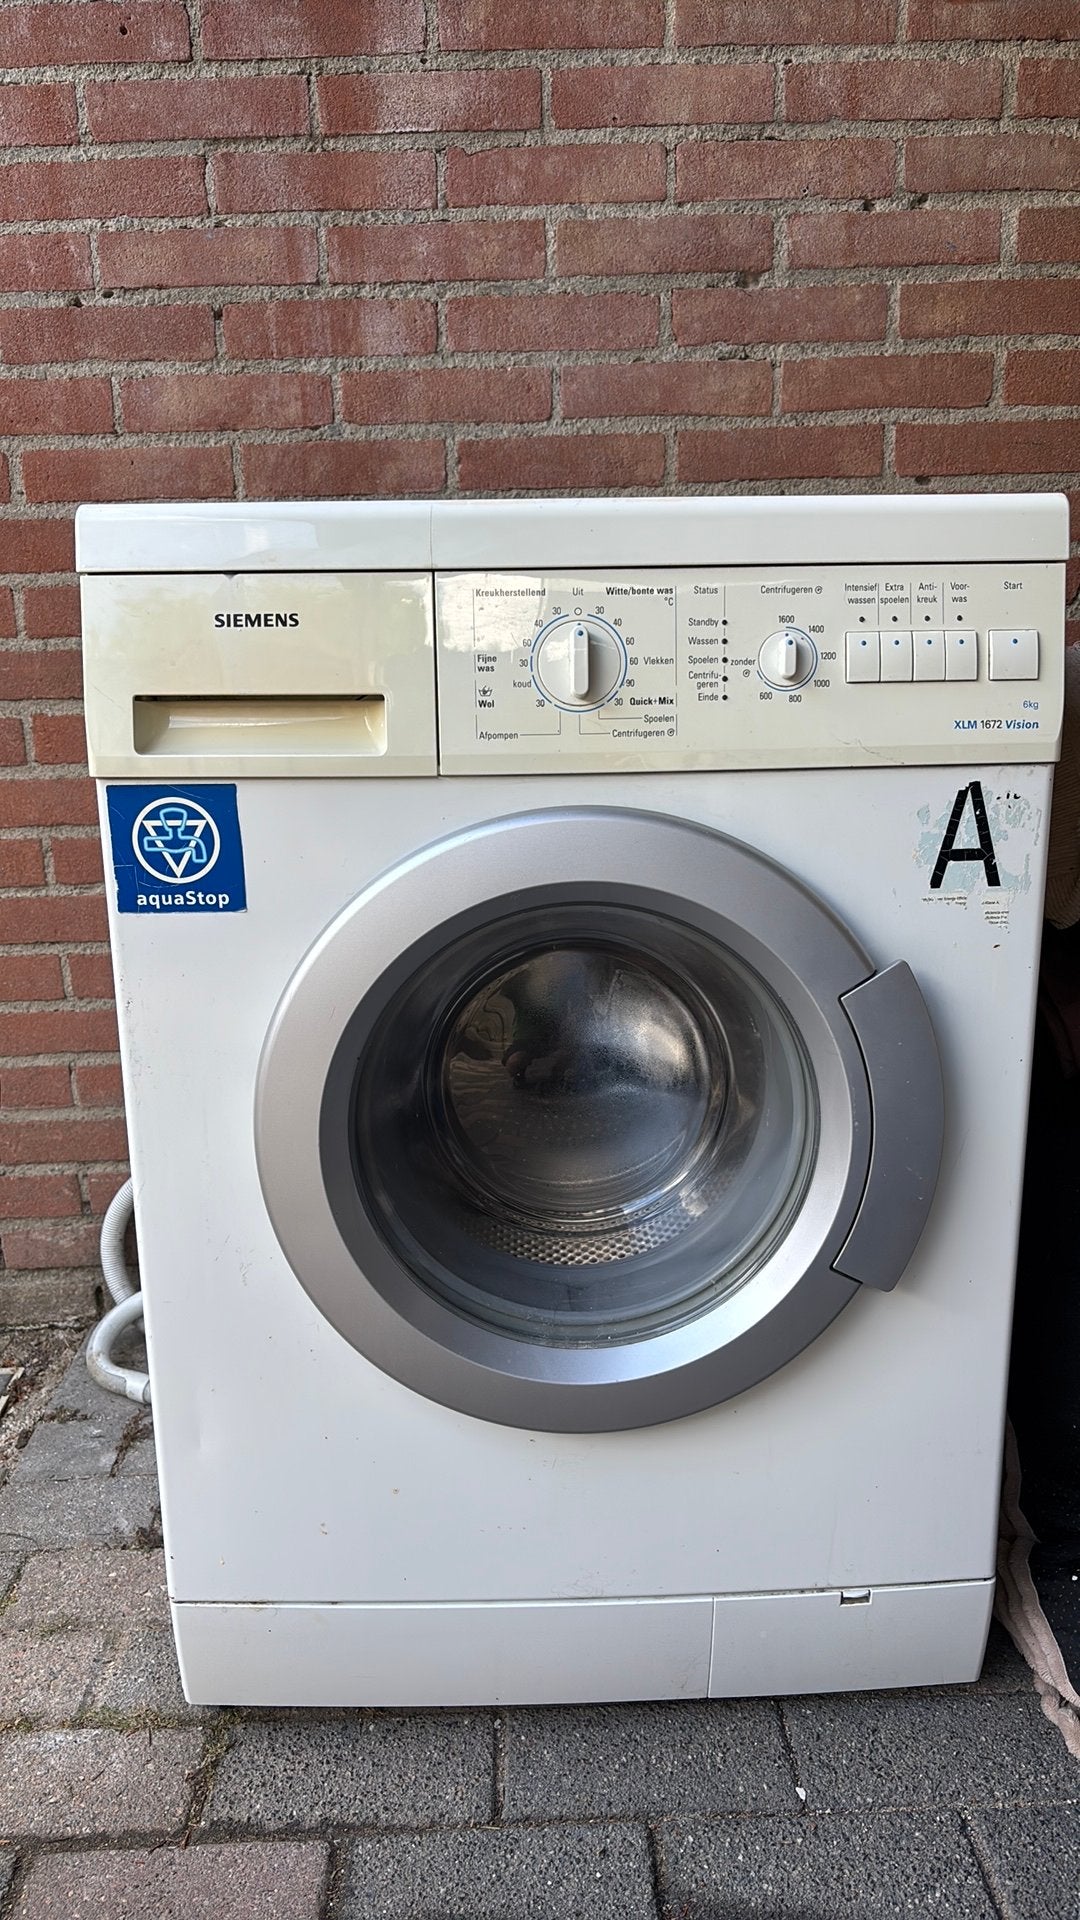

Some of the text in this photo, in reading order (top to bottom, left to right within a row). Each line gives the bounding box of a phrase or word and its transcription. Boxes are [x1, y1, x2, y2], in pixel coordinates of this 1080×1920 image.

[694, 586, 718, 594] Status
[761, 585, 813, 595] Centrifugeren
[845, 583, 877, 592] Intensief
[885, 583, 904, 591] Extra
[919, 582, 937, 590] Anti-
[950, 582, 970, 590] Voor-
[1004, 582, 1022, 590] Start
[606, 587, 654, 595] Witte/bonte
[880, 596, 909, 605] spoelen
[917, 595, 938, 603] kreuk
[596, 606, 604, 614] 30
[214, 613, 299, 628] SIEMENS
[688, 618, 718, 627] Standby
[477, 655, 497, 664] Fijne
[630, 657, 674, 665] 60 Vlekken
[688, 656, 718, 665] Spoelen
[478, 700, 494, 708] Wol
[630, 697, 674, 706] Quick+Mix
[1023, 701, 1039, 710] 6kg
[644, 714, 674, 724] Spoelen
[954, 720, 1039, 729] XLM 1672 Vision
[479, 731, 518, 740] Afpompen
[612, 729, 665, 738] Centrifugeren
[930, 781, 1001, 889] A
[137, 891, 229, 908] aquaStop
